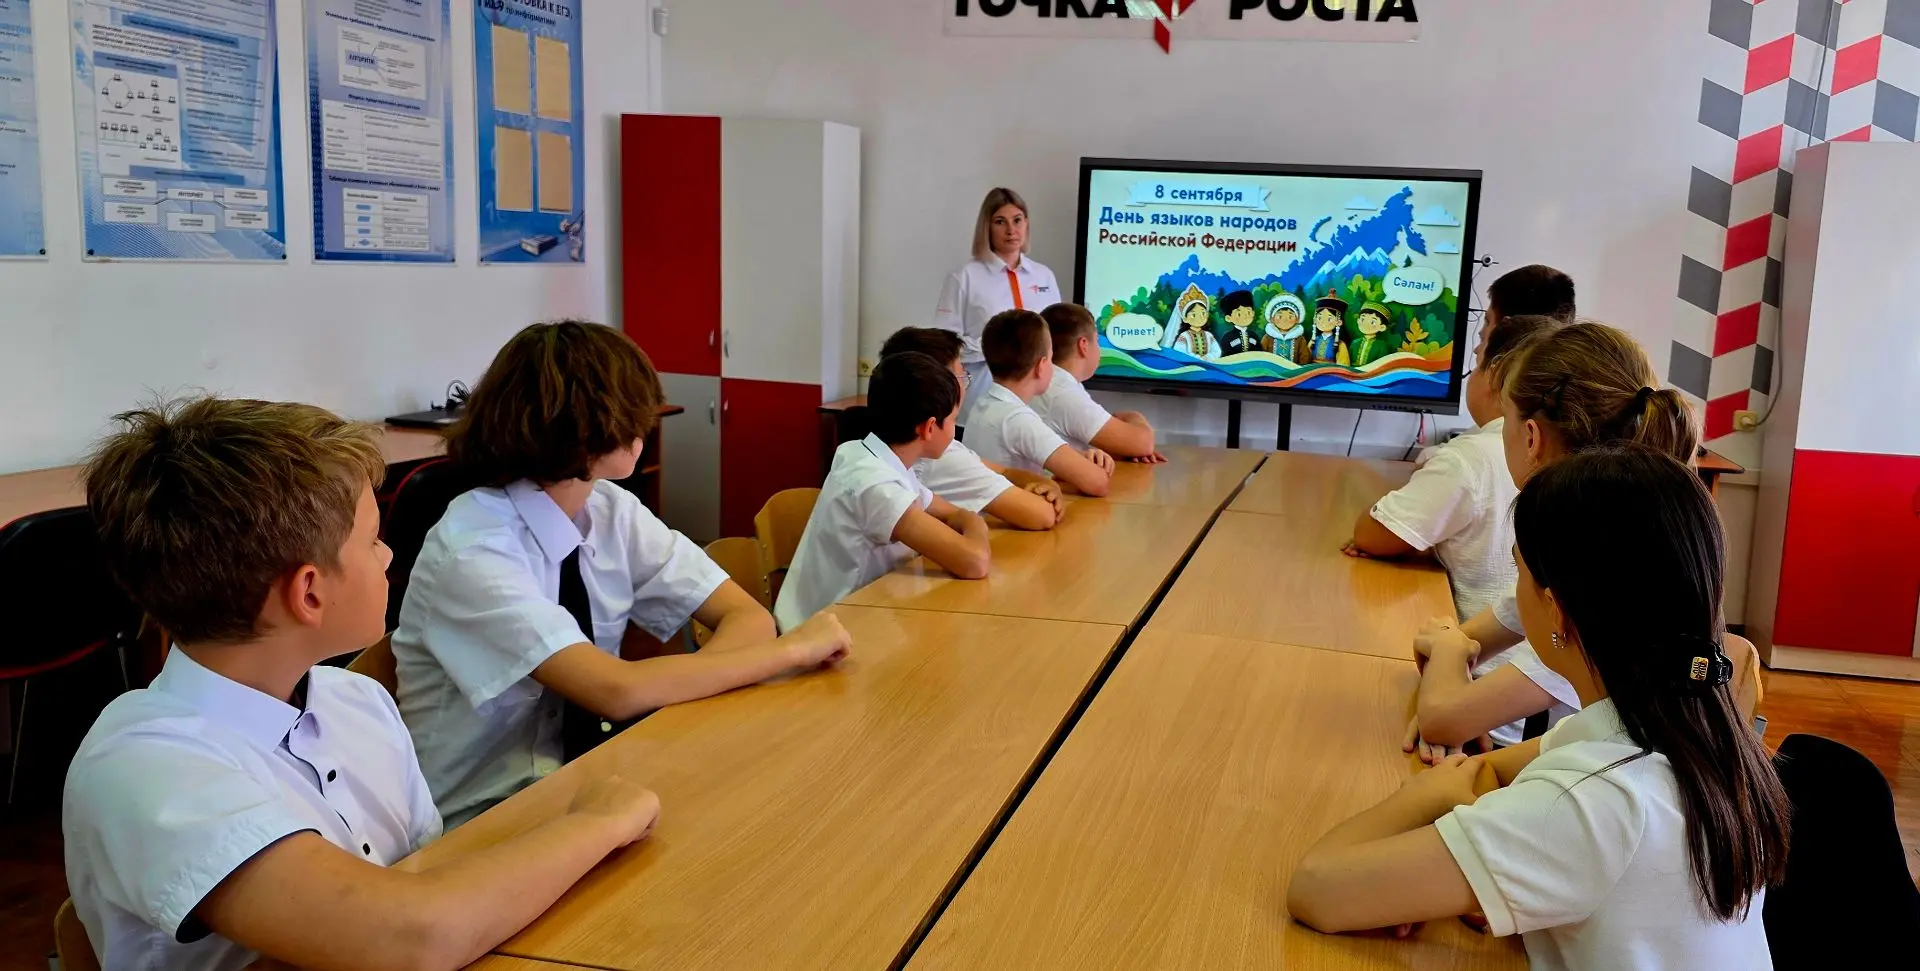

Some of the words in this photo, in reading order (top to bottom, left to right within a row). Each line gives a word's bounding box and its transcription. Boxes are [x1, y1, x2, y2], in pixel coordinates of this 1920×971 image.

[1155, 184, 1164, 199] 8
[1171, 187, 1243, 204] сентября
[1099, 206, 1145, 225] День
[1150, 213, 1214, 227] языков
[1220, 216, 1297, 232] народов
[1099, 229, 1196, 248] Российской
[1201, 233, 1297, 253] Федерации
[1113, 326, 1155, 339] Привет!
